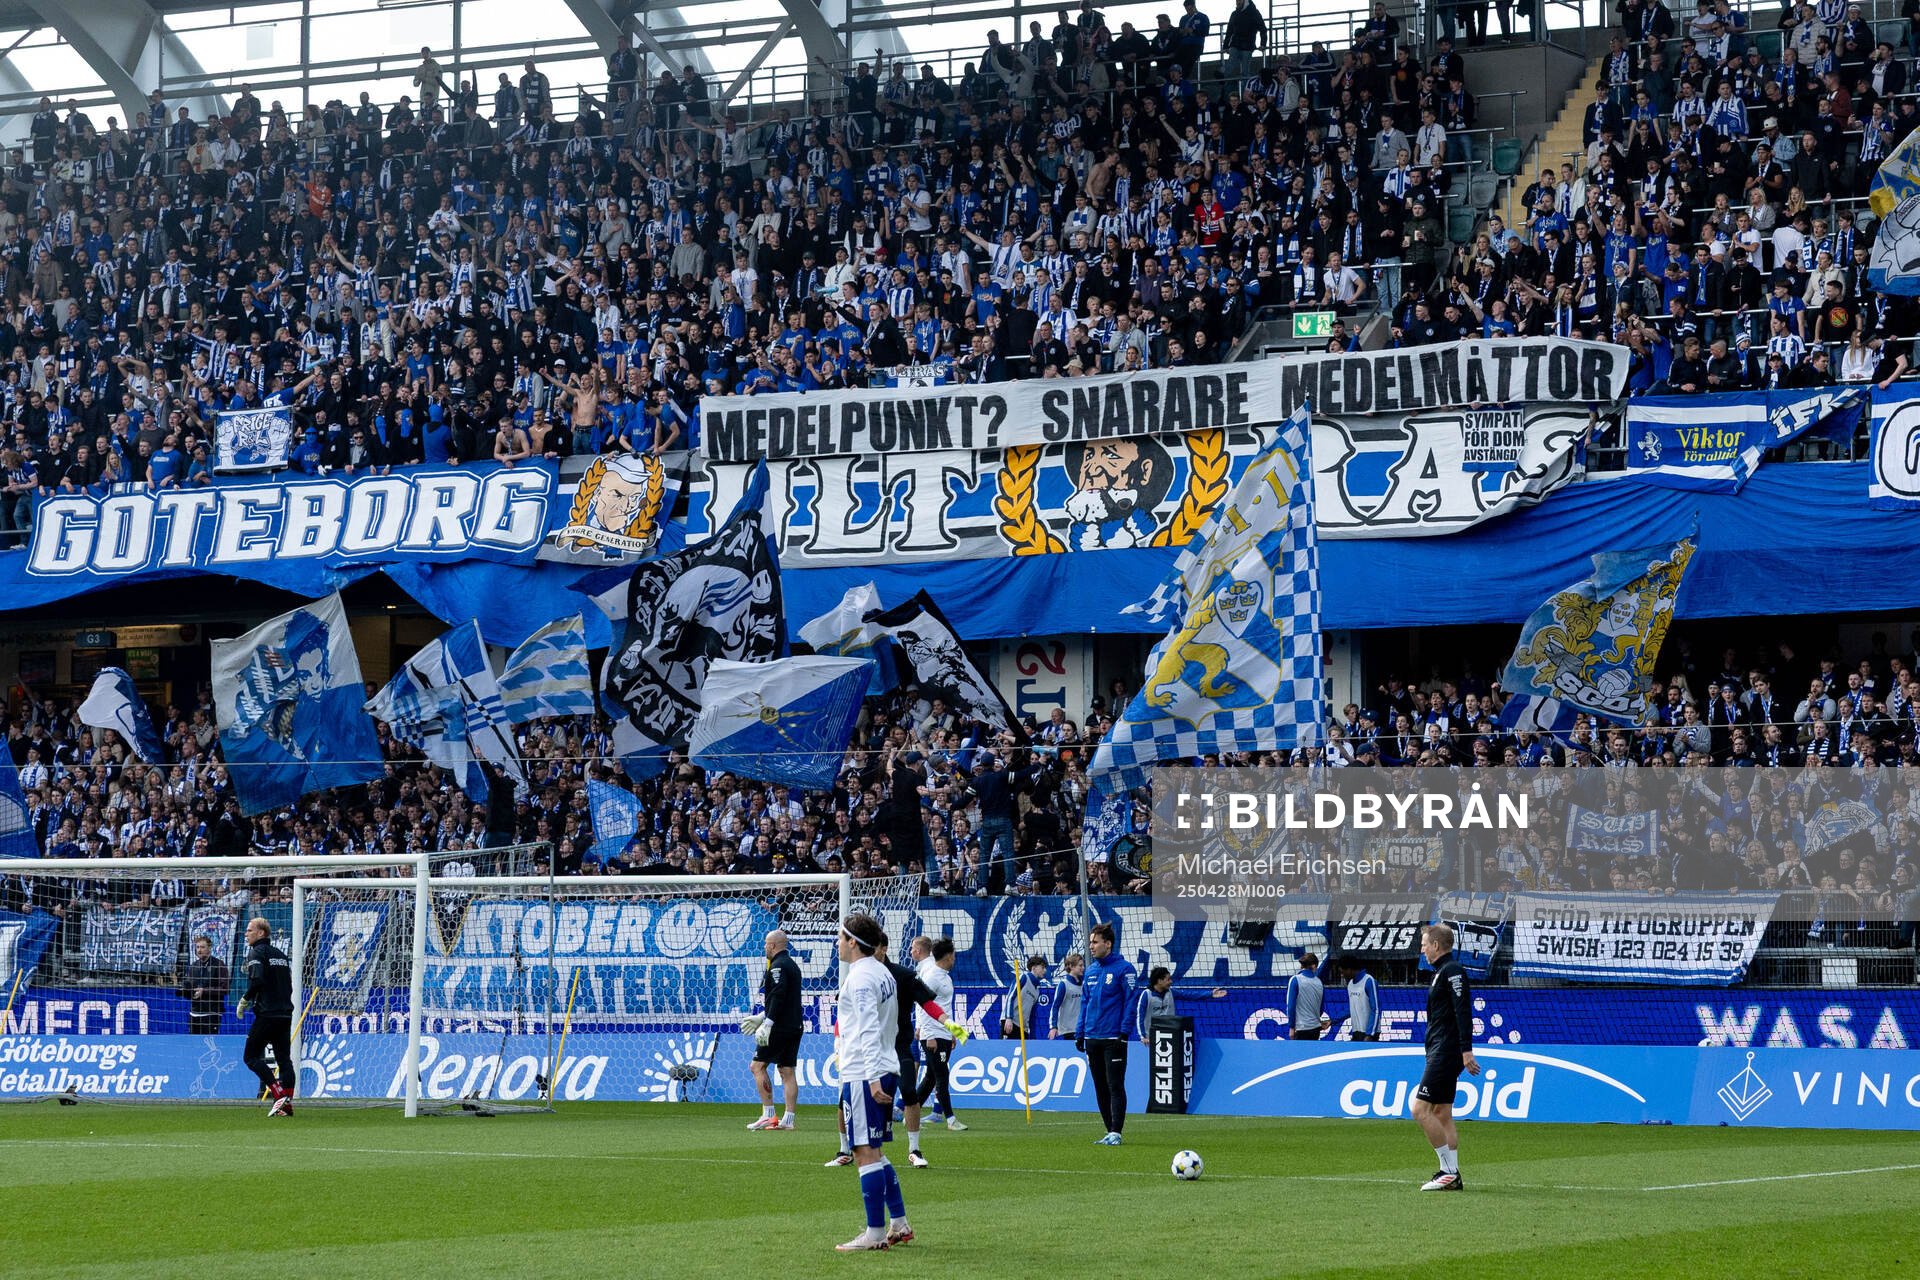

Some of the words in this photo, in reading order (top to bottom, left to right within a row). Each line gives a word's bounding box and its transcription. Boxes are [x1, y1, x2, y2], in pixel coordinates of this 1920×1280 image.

[706, 395, 1008, 461] MEDELPUNKT?
[1041, 371, 1250, 443] SNARARE
[1281, 345, 1614, 419] MEDELMÅTTOR
[1464, 428, 1489, 447] FÖR
[1493, 430, 1525, 447] DOM
[1675, 427, 1745, 449] Viktor
[1463, 446, 1522, 462] AVSTÄNGD
[28, 467, 553, 576] GÖTEBORG
[1387, 845, 1425, 867] GBG
[1338, 903, 1425, 927] HATA
[1534, 904, 1591, 932] STÖD
[1600, 911, 1757, 936] TIFOGRUPPEN
[1341, 927, 1416, 950] GAIS
[1537, 935, 1606, 958] SWISH:
[1613, 939, 1645, 959] 123
[1652, 941, 1688, 961] 024
[1697, 942, 1714, 961] 15
[1719, 942, 1744, 962] 39
[0, 1067, 169, 1094] etallpartier
[386, 1035, 609, 1101] Renova
[949, 1046, 1088, 1106] esign
[1155, 1030, 1173, 1105] SELECT
[1183, 1030, 1193, 1104] SELECT
